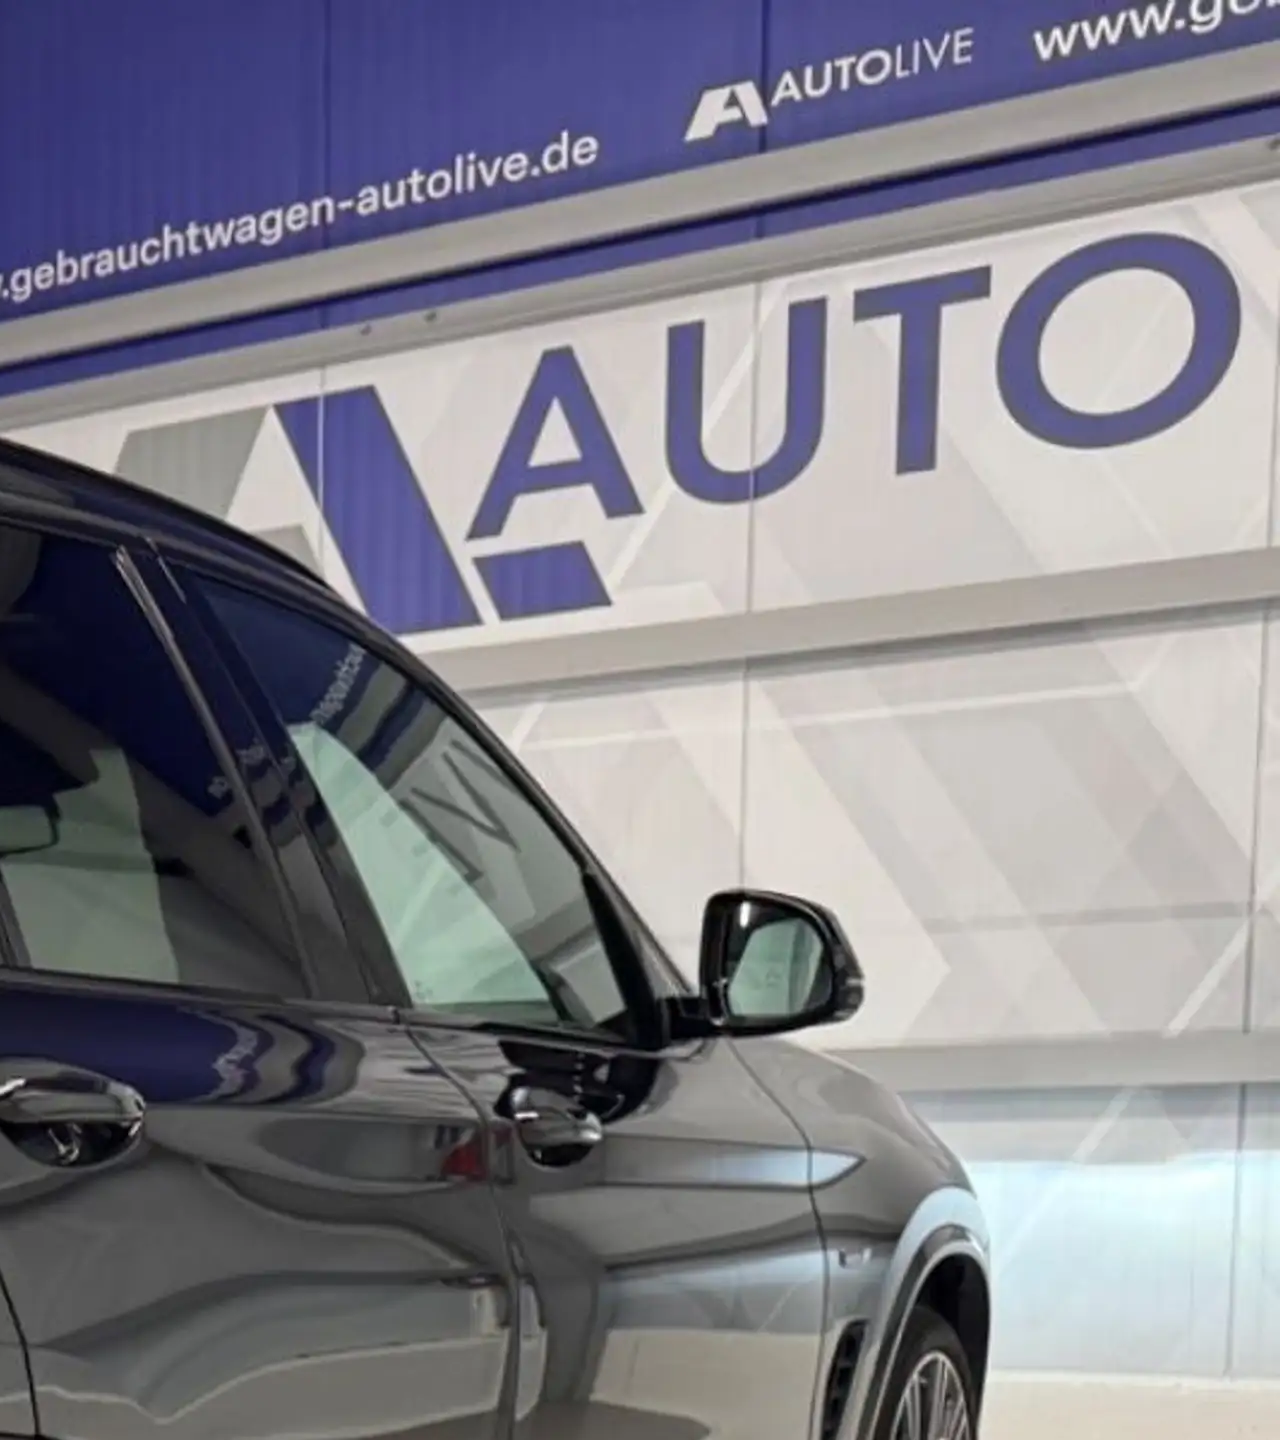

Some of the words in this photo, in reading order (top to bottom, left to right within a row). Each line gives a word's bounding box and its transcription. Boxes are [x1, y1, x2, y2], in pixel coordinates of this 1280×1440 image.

[770, 26, 974, 107] AUTOLIVE
[1032, 0, 1280, 61] www.g
[464, 231, 1242, 543] AUTO
